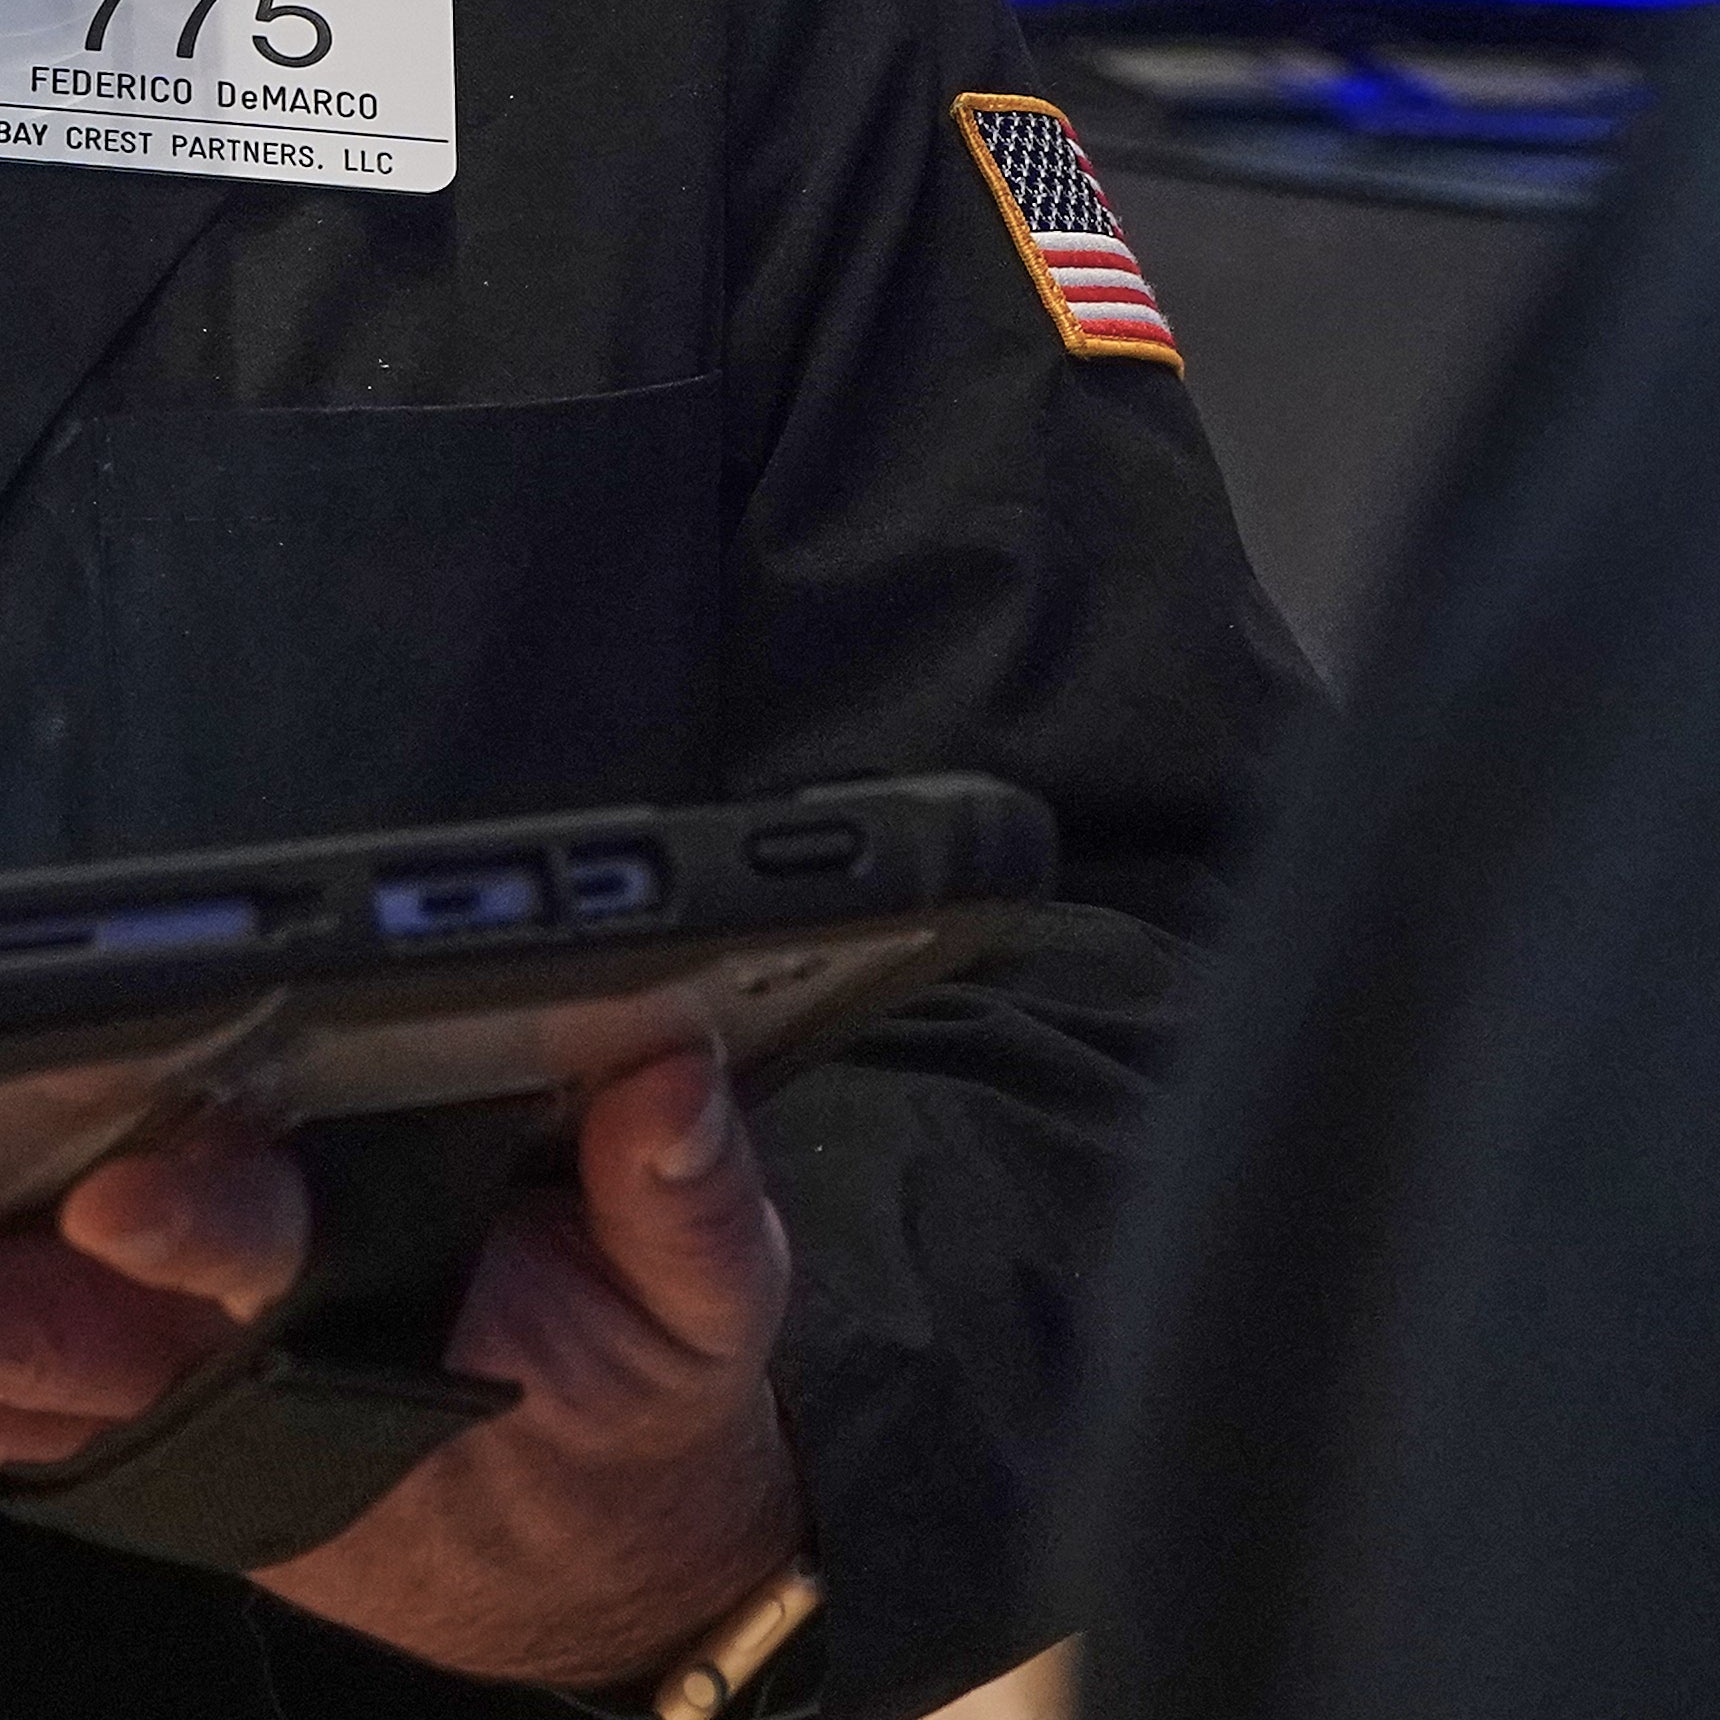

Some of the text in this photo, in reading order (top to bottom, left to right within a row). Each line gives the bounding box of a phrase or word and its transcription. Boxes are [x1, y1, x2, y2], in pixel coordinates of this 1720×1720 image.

[32, 67, 378, 120] FEDERICO DeMARCO
[66, 127, 153, 155] CREST
[344, 149, 393, 175] LLC
